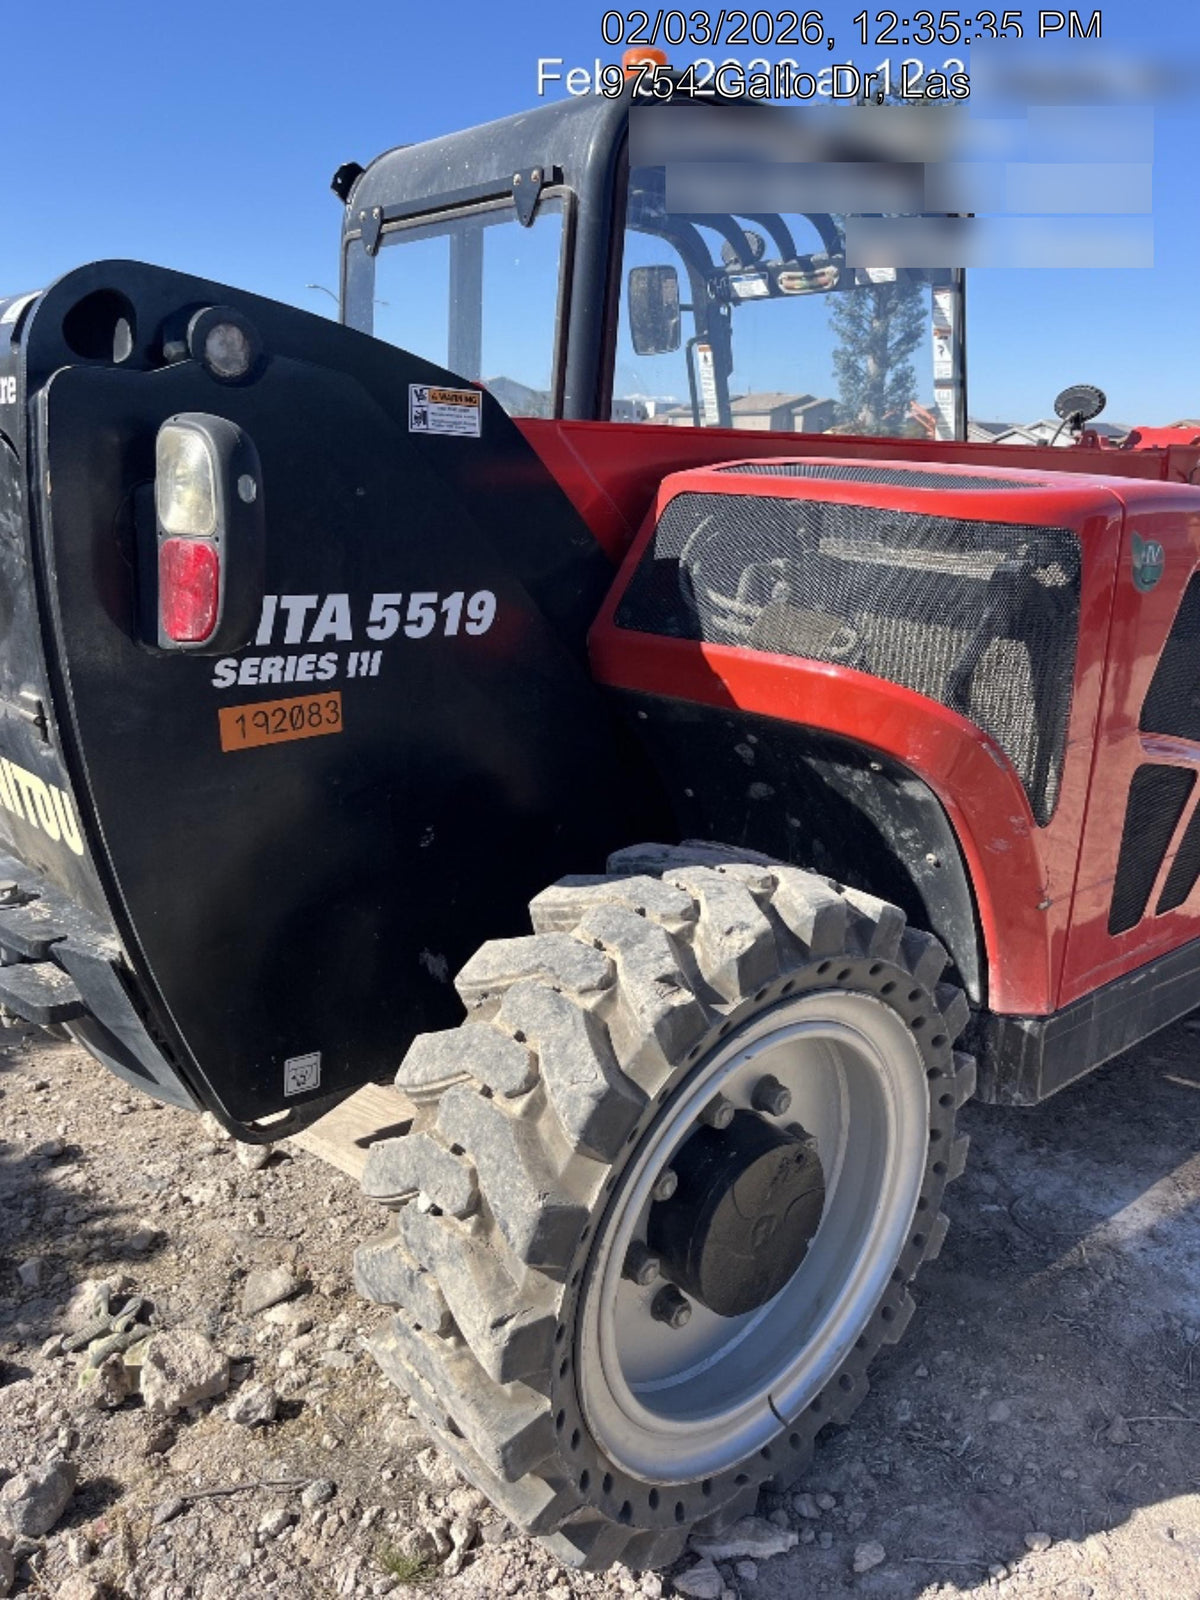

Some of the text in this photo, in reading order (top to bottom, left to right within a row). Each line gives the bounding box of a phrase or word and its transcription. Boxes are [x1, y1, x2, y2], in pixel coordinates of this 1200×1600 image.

[365, 590, 497, 641] 5519
[211, 650, 383, 689] SERIES III
[235, 700, 340, 739] 192083
